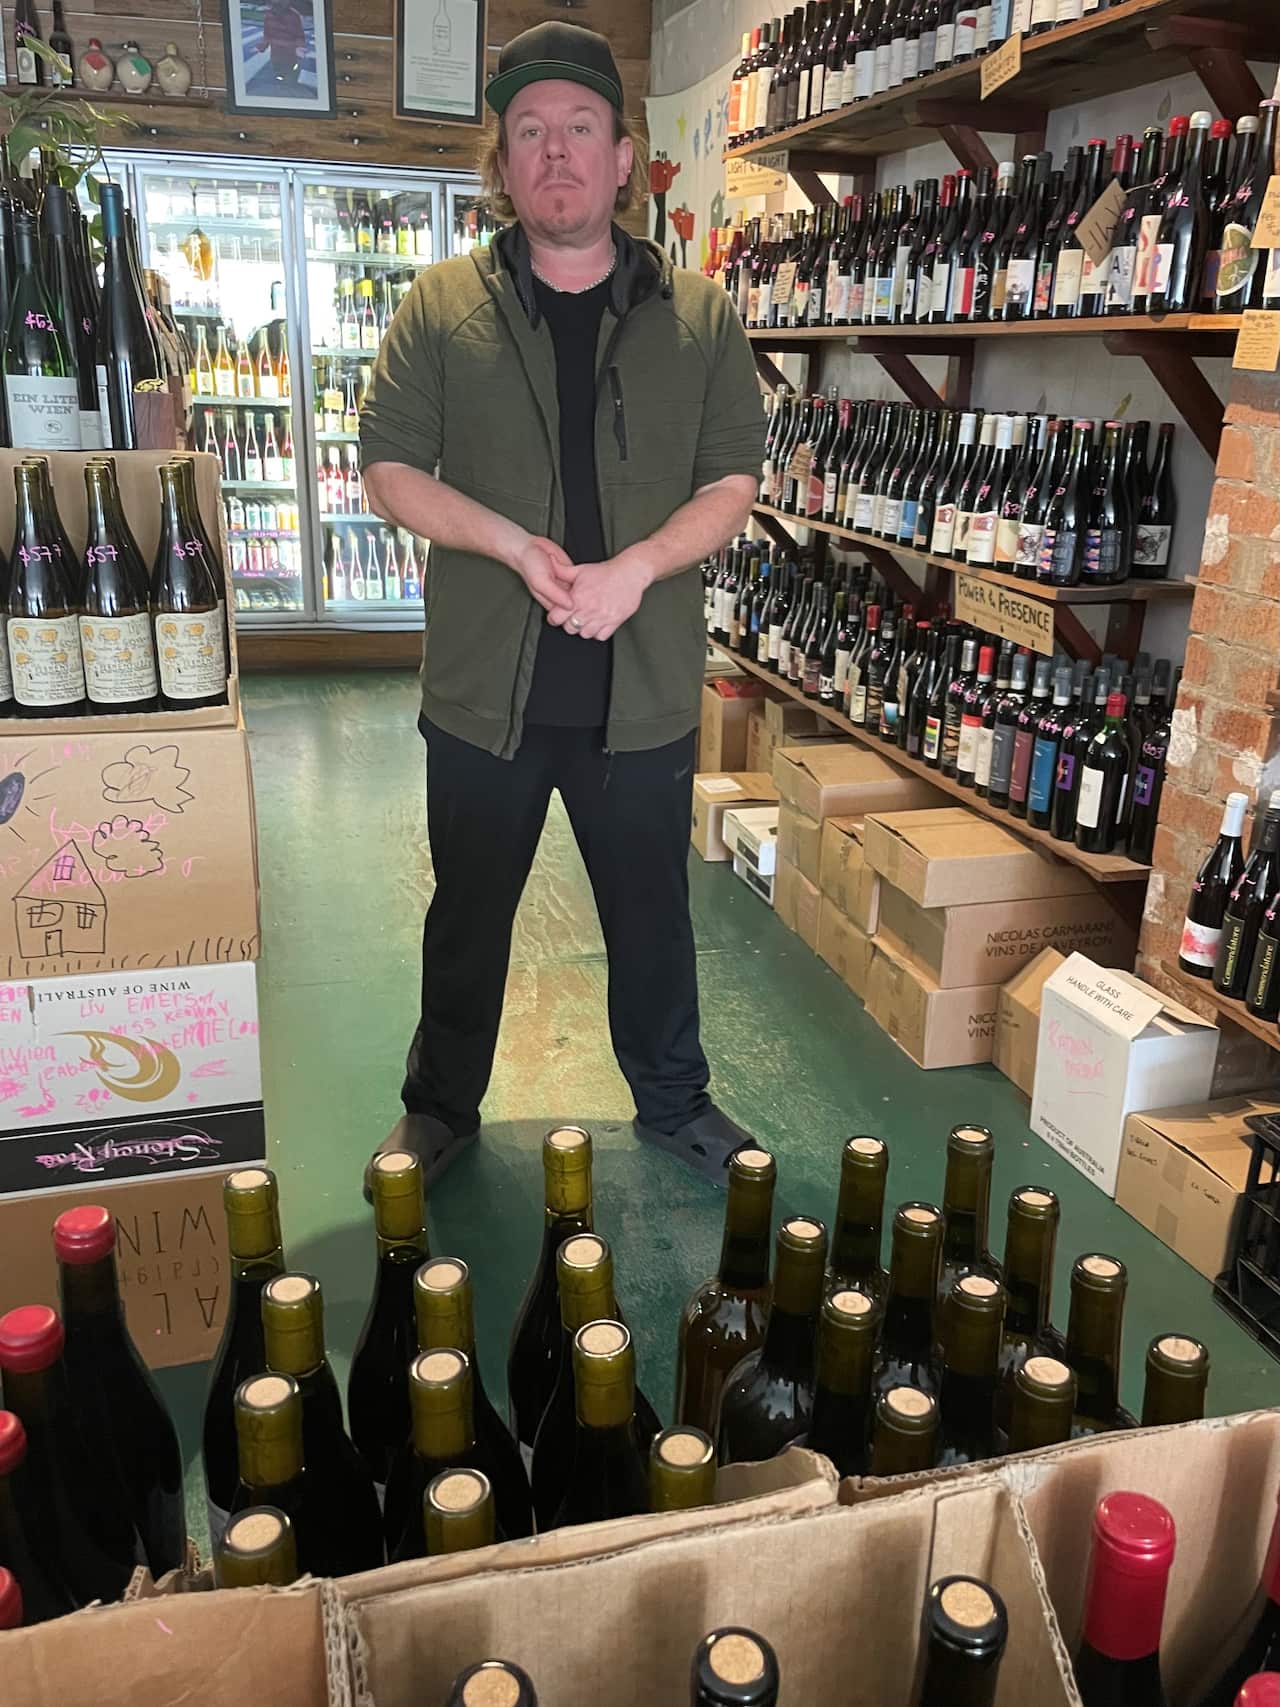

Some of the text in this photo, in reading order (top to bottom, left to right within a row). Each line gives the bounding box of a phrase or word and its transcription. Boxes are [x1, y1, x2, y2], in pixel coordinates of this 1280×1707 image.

[28, 405, 73, 415] WIEN
[86, 544, 118, 566] $57
[960, 577, 986, 604] POWER
[999, 592, 1050, 632] PRESENCE
[987, 927, 1041, 943] NICOLAS
[985, 945, 1015, 957] VINS
[1018, 943, 1037, 955] DE
[38, 986, 118, 1003] AUSTRALI
[123, 984, 144, 996] OF
[150, 980, 191, 993] WINE
[1095, 980, 1122, 999] GLASS
[1065, 975, 1096, 998] HANDLE
[1093, 994, 1113, 1010] WITH
[1112, 1004, 1136, 1022] CARE
[1040, 1115, 1066, 1140] PRODUCT
[1074, 1144, 1105, 1174] AUSTRALIA
[1070, 1150, 1096, 1176] BOTTLES
